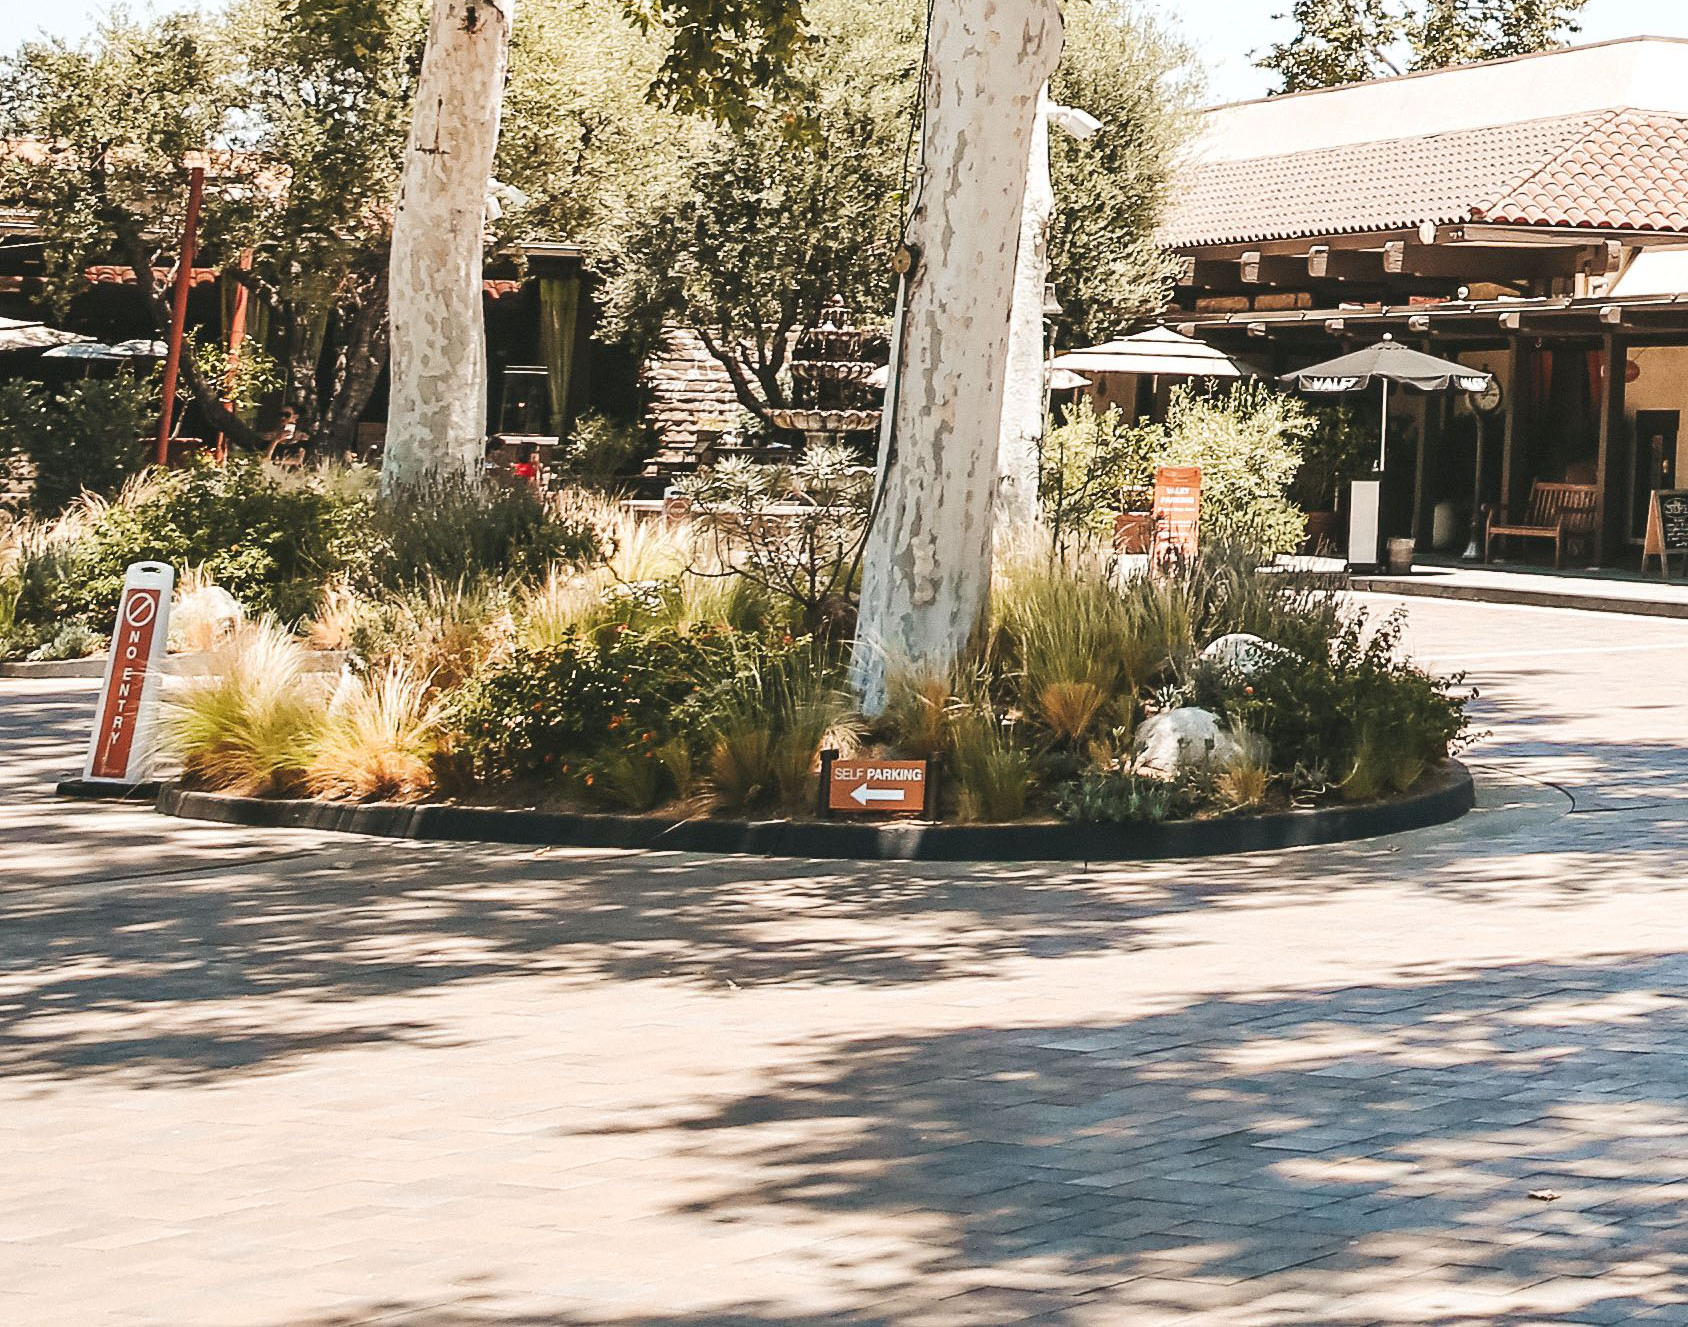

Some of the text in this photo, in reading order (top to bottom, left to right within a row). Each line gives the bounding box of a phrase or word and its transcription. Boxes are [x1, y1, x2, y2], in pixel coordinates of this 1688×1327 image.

[110, 630, 141, 745] NO ENTRY
[834, 767, 922, 781] SELF PARKING
